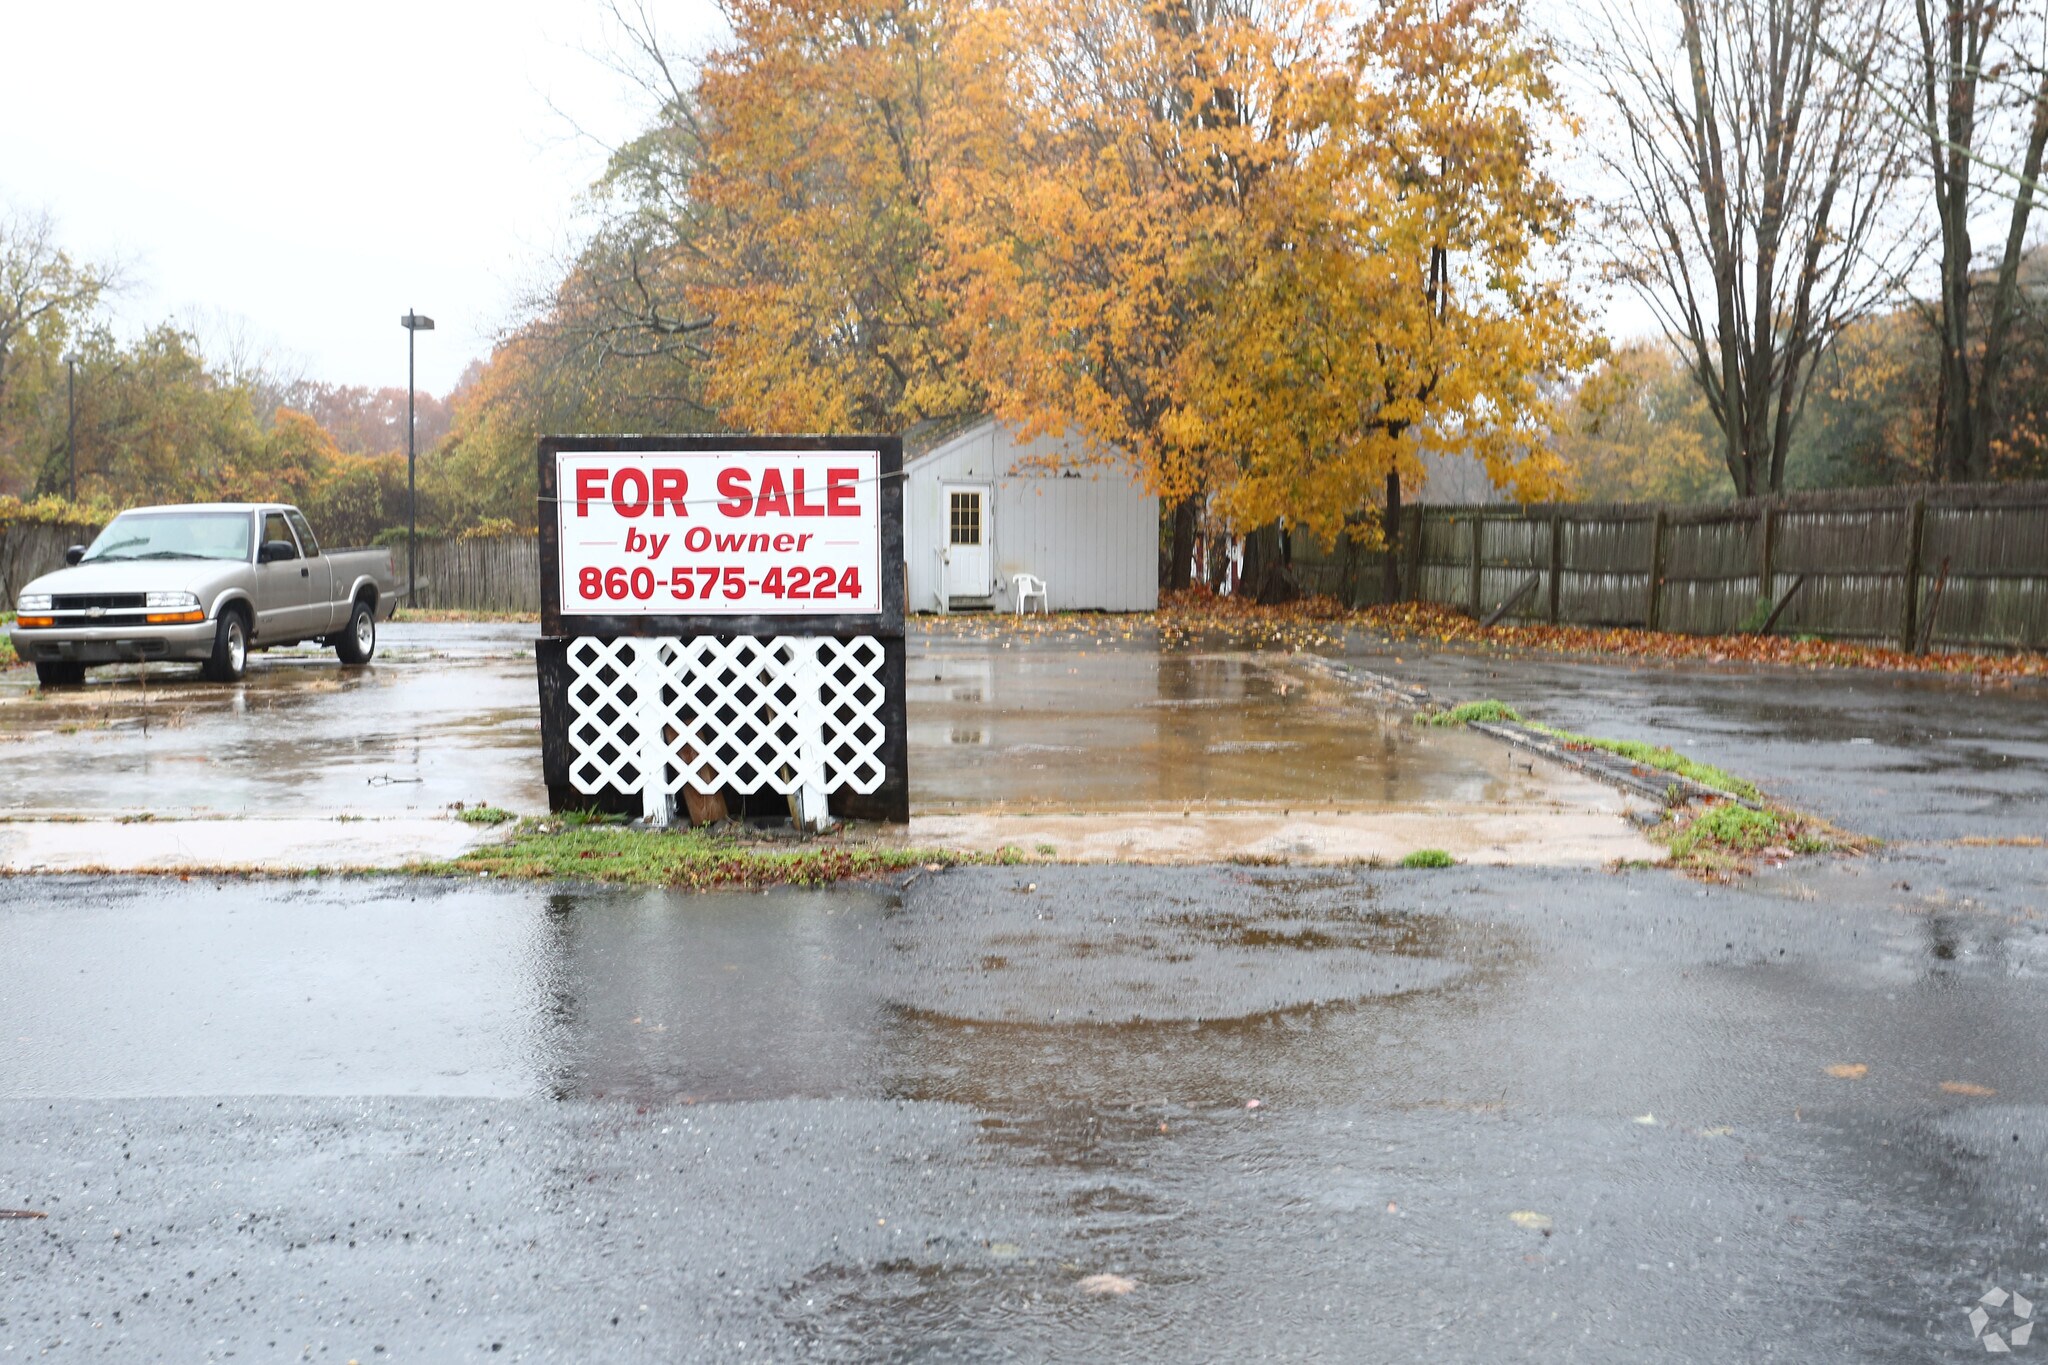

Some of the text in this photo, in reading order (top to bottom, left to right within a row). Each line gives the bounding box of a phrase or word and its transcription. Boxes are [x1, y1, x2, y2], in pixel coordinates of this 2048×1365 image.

[576, 467, 862, 519] FOR SALE
[625, 525, 814, 561] by Owner
[578, 565, 863, 601] 860-575-4224
